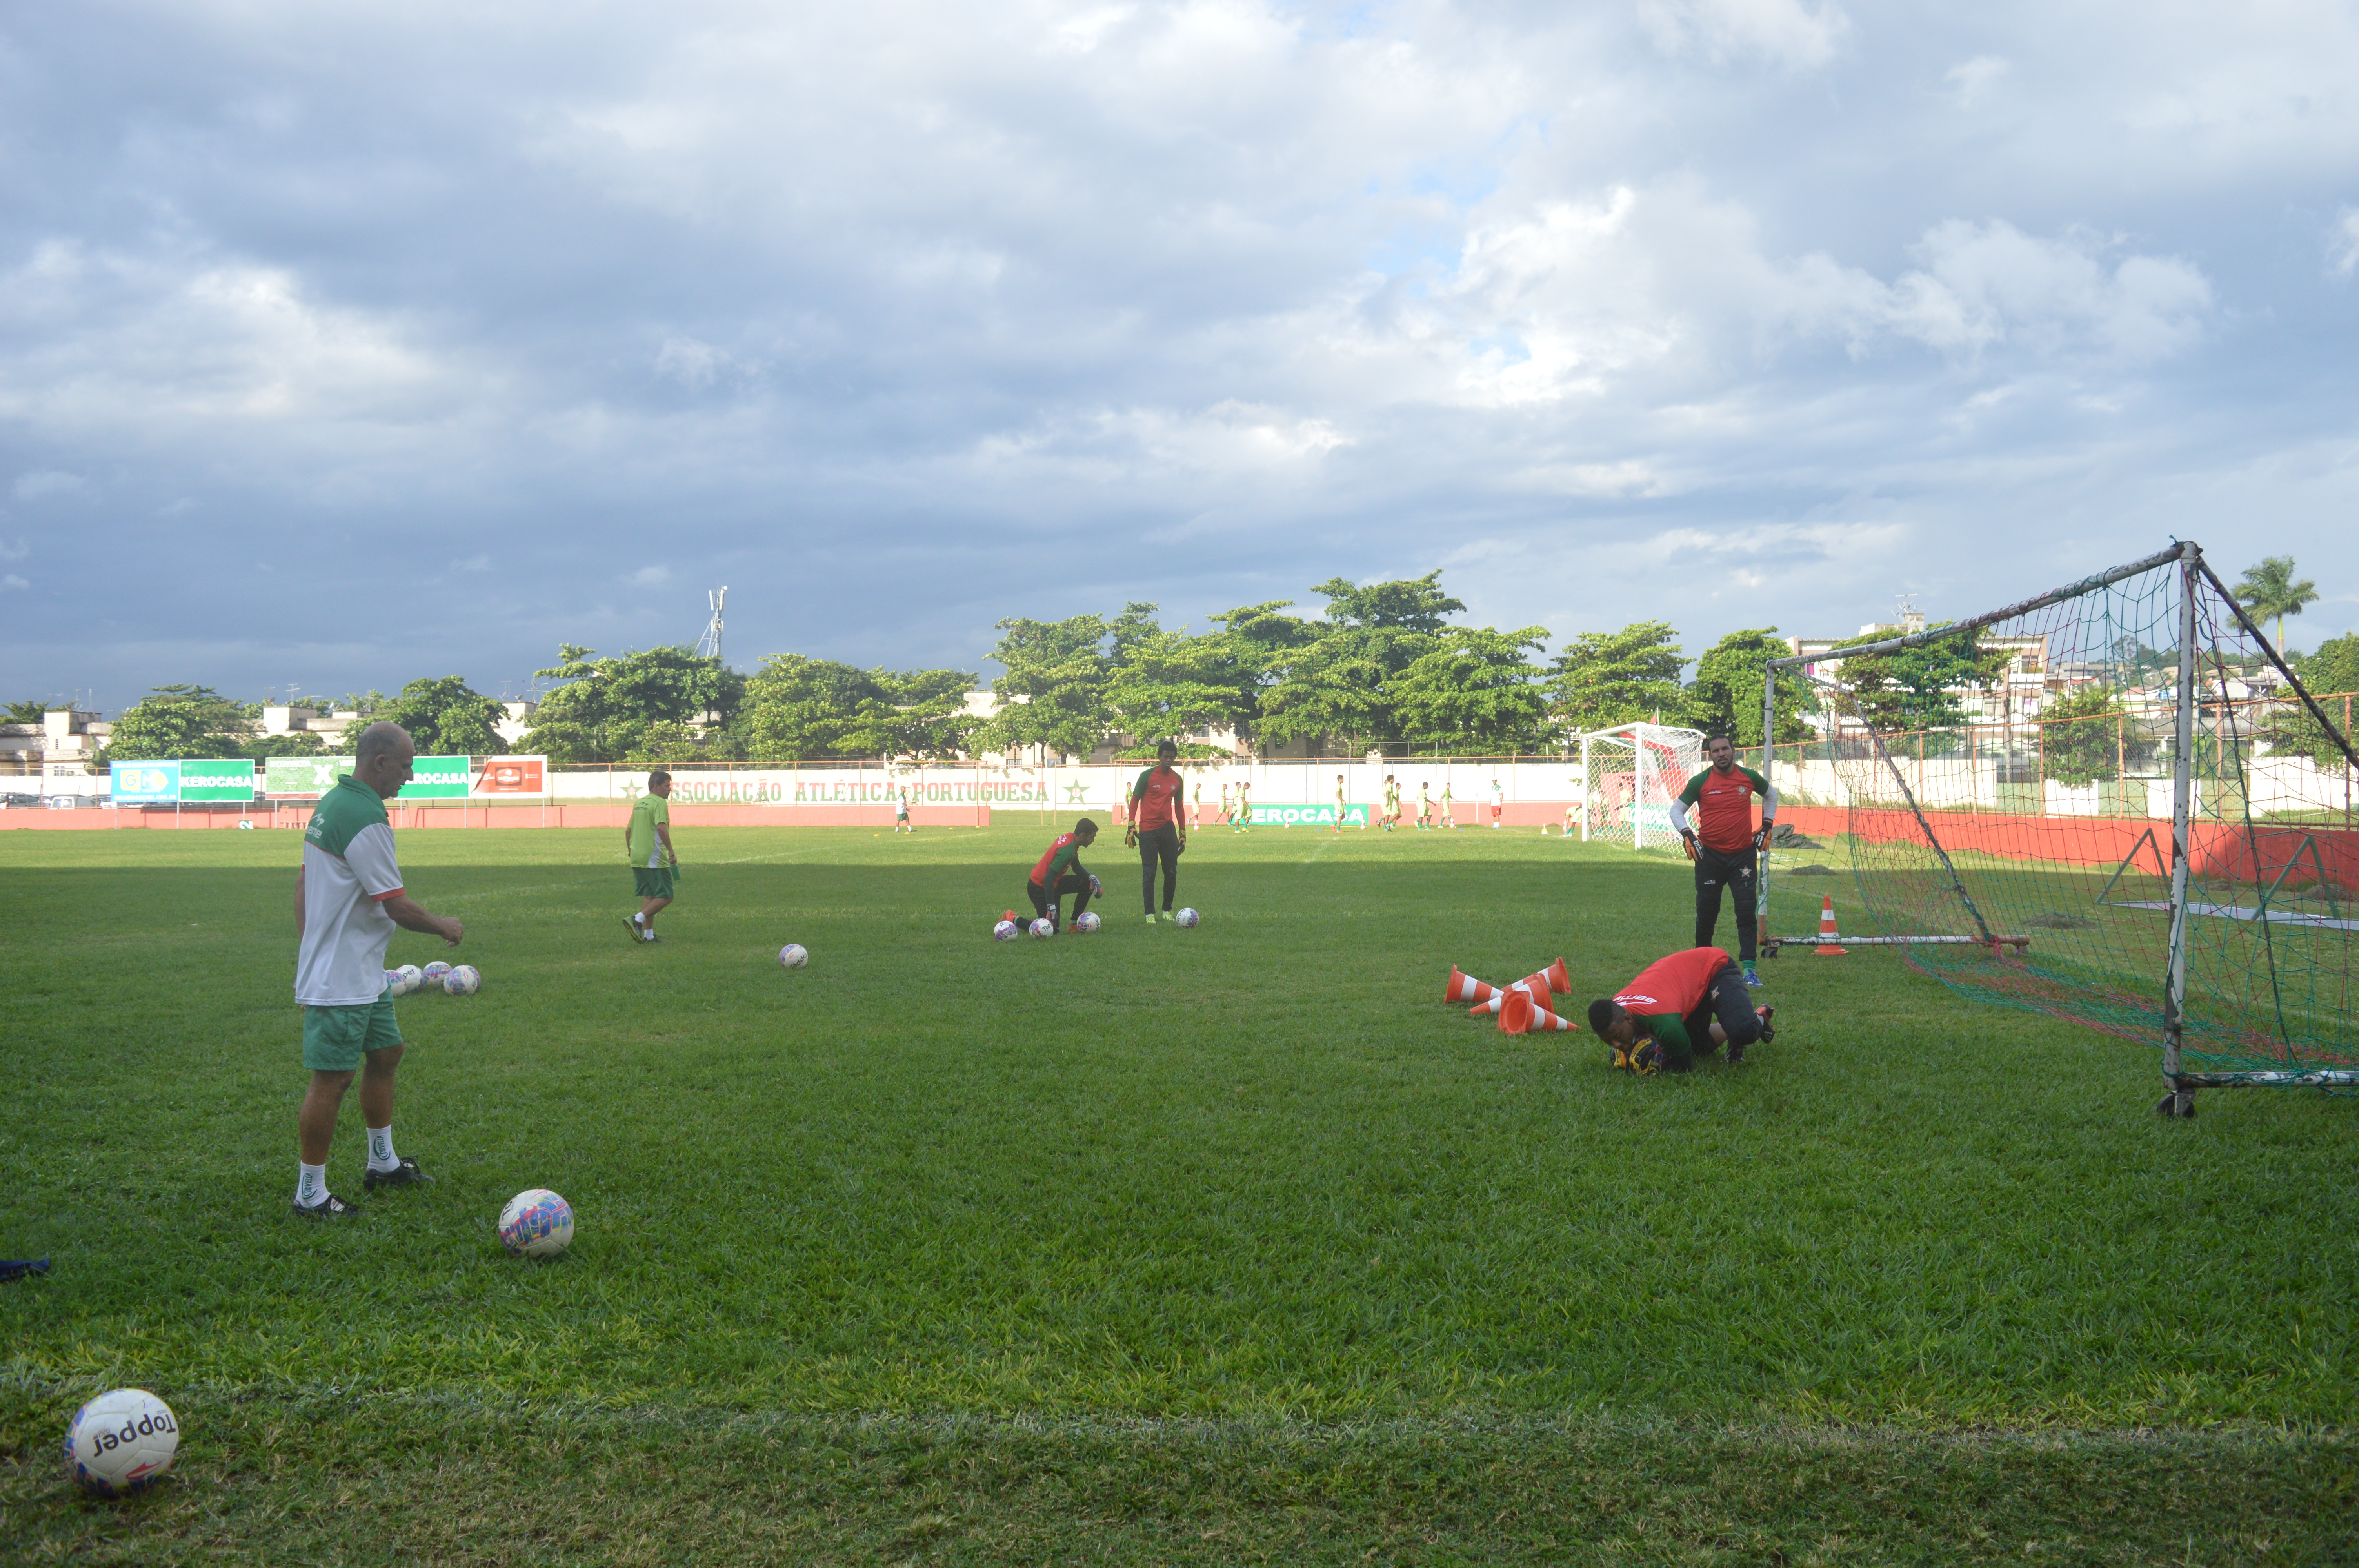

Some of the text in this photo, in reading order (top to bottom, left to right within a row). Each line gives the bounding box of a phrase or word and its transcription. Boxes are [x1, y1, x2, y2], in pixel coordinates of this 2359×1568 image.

[181, 776, 253, 788] KEROCASA
[405, 772, 468, 784] ROCASA
[794, 779, 897, 802] ATLÉTICA
[912, 782, 1049, 802] PORTUGUESA
[1250, 808, 1364, 822] EROCASA
[304, 1173, 313, 1192] TRIVELLA
[93, 1414, 176, 1458] Topper
